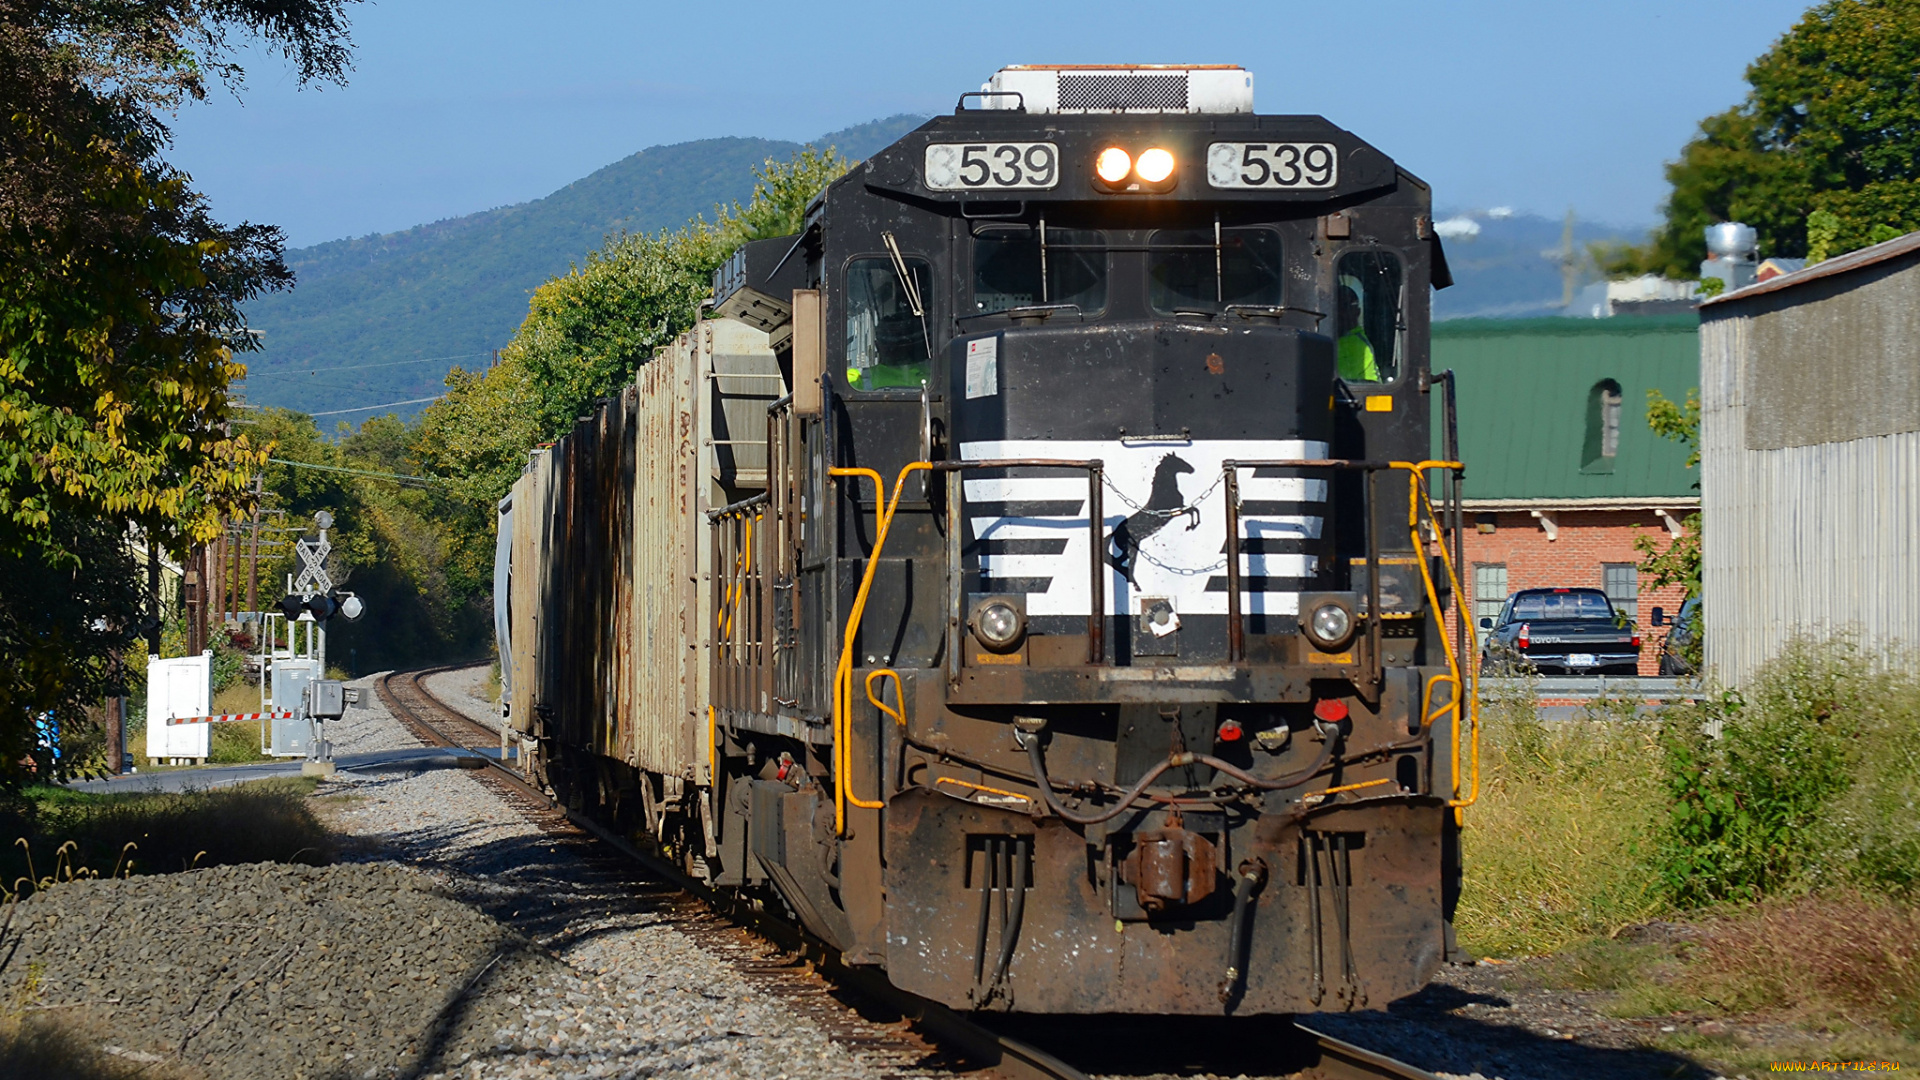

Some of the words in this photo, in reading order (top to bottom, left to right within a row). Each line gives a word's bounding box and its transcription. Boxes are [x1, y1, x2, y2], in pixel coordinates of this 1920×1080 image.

[297, 542, 311, 563] RAIL
[315, 569, 330, 590] ROAD
[297, 544, 328, 588] CROSSING
[1530, 636, 1561, 644] TOYOTA
